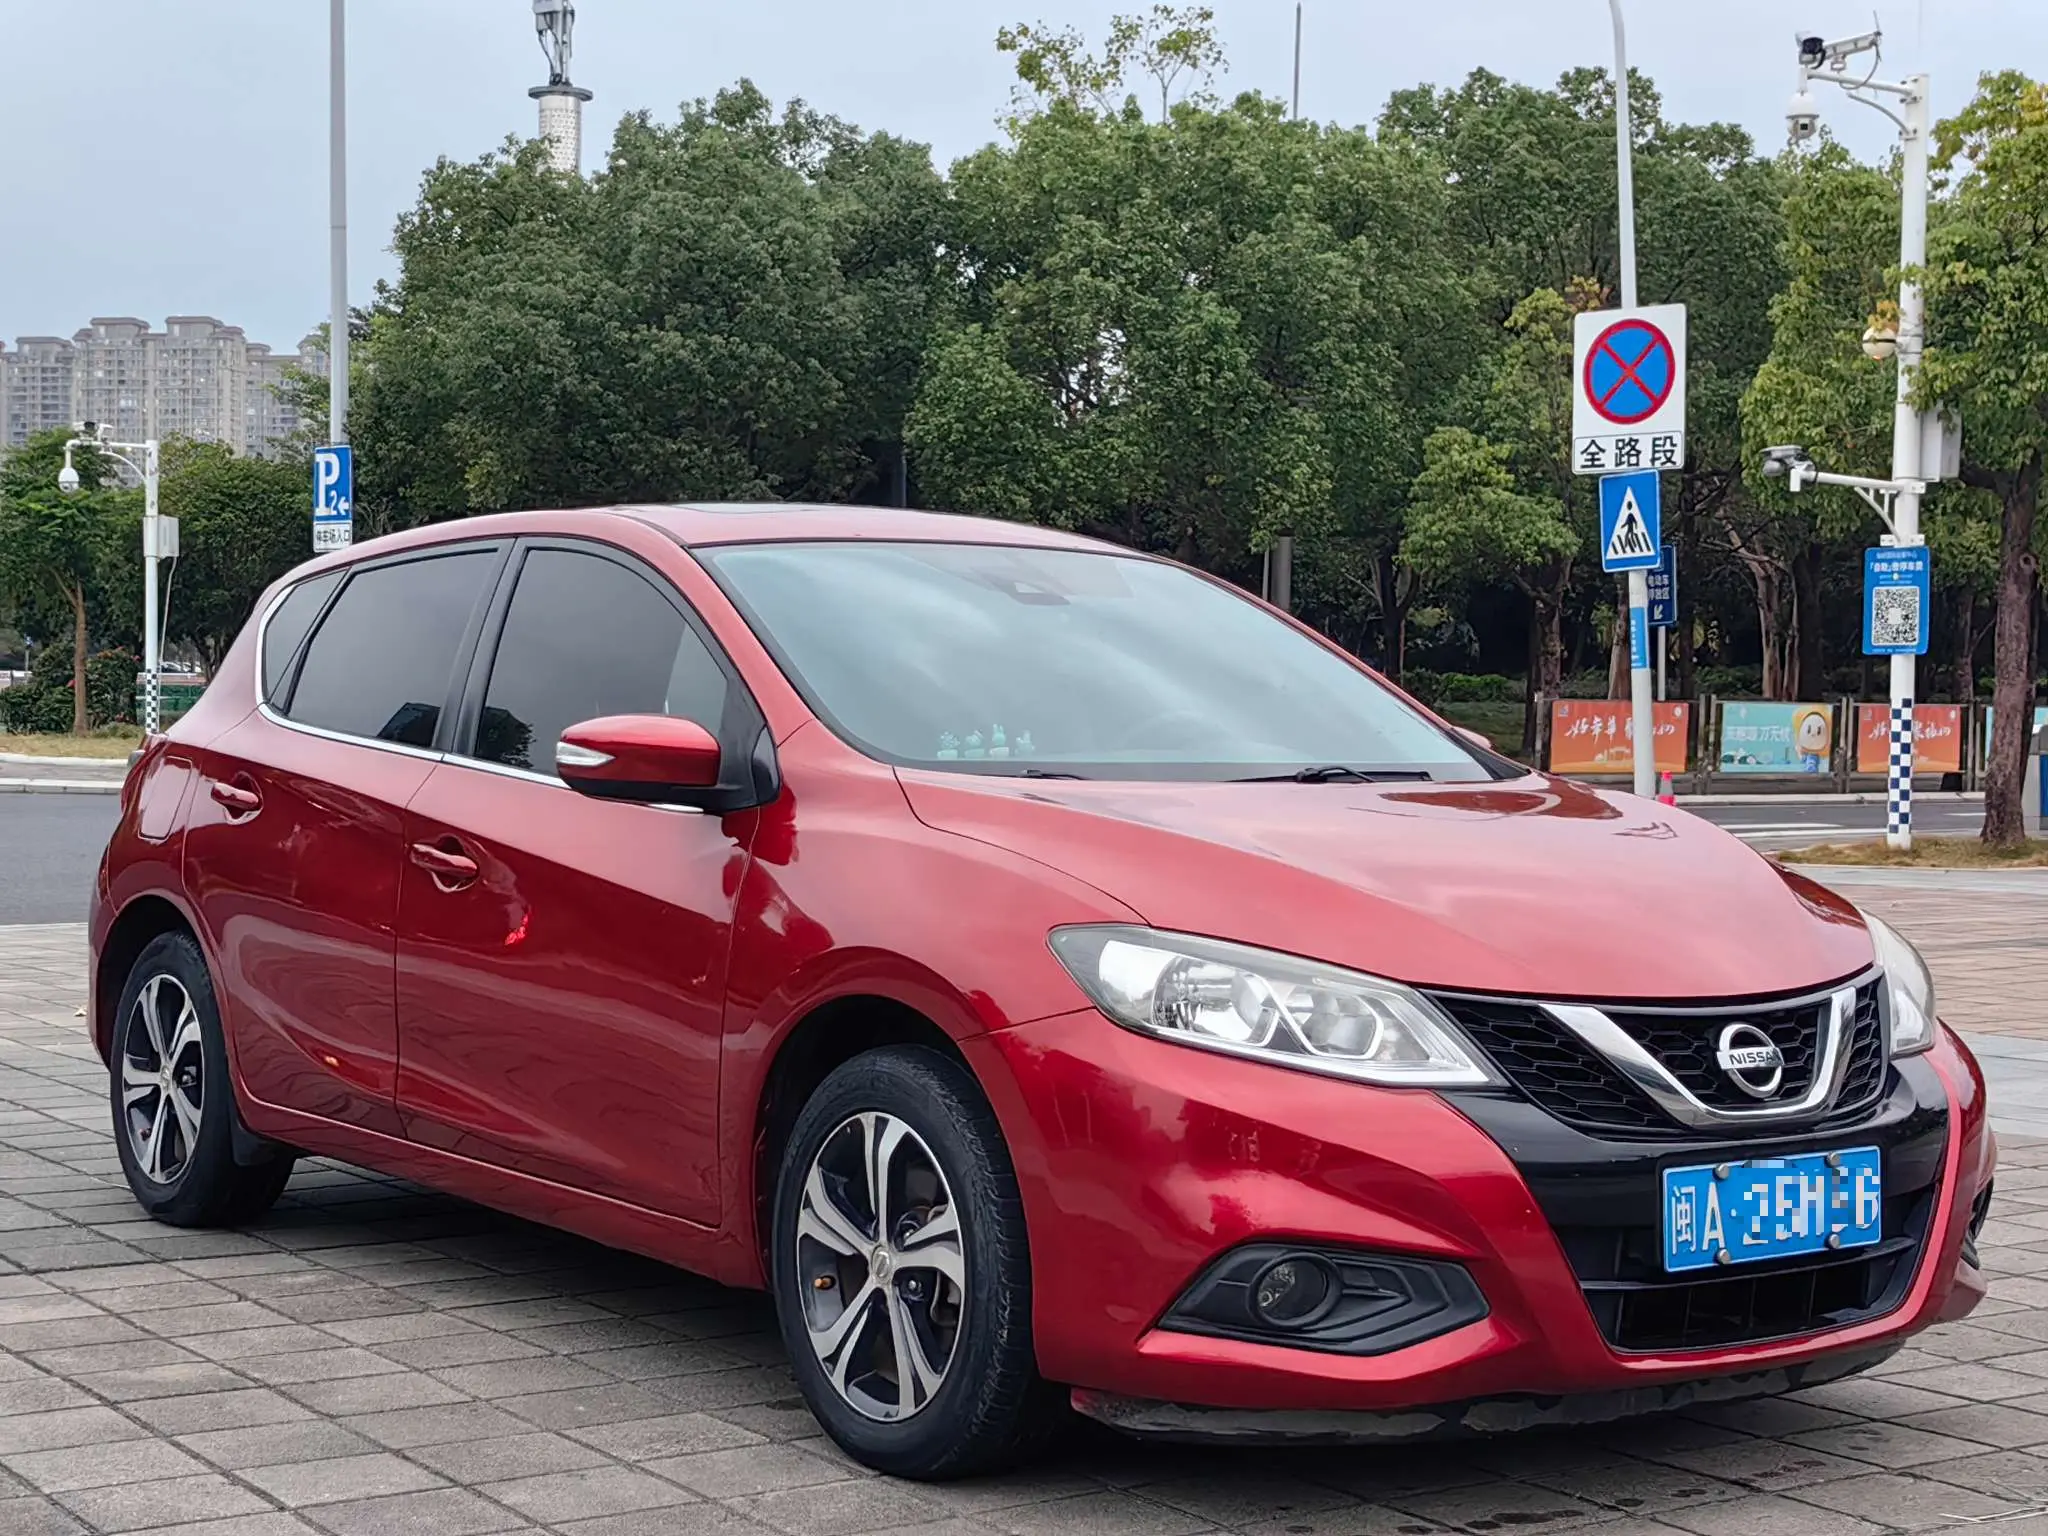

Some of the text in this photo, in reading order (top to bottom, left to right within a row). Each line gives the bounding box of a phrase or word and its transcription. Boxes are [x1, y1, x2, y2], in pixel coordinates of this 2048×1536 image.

[1580, 436, 1677, 468] 全路段
[1729, 1050, 1781, 1065] NISSAN
